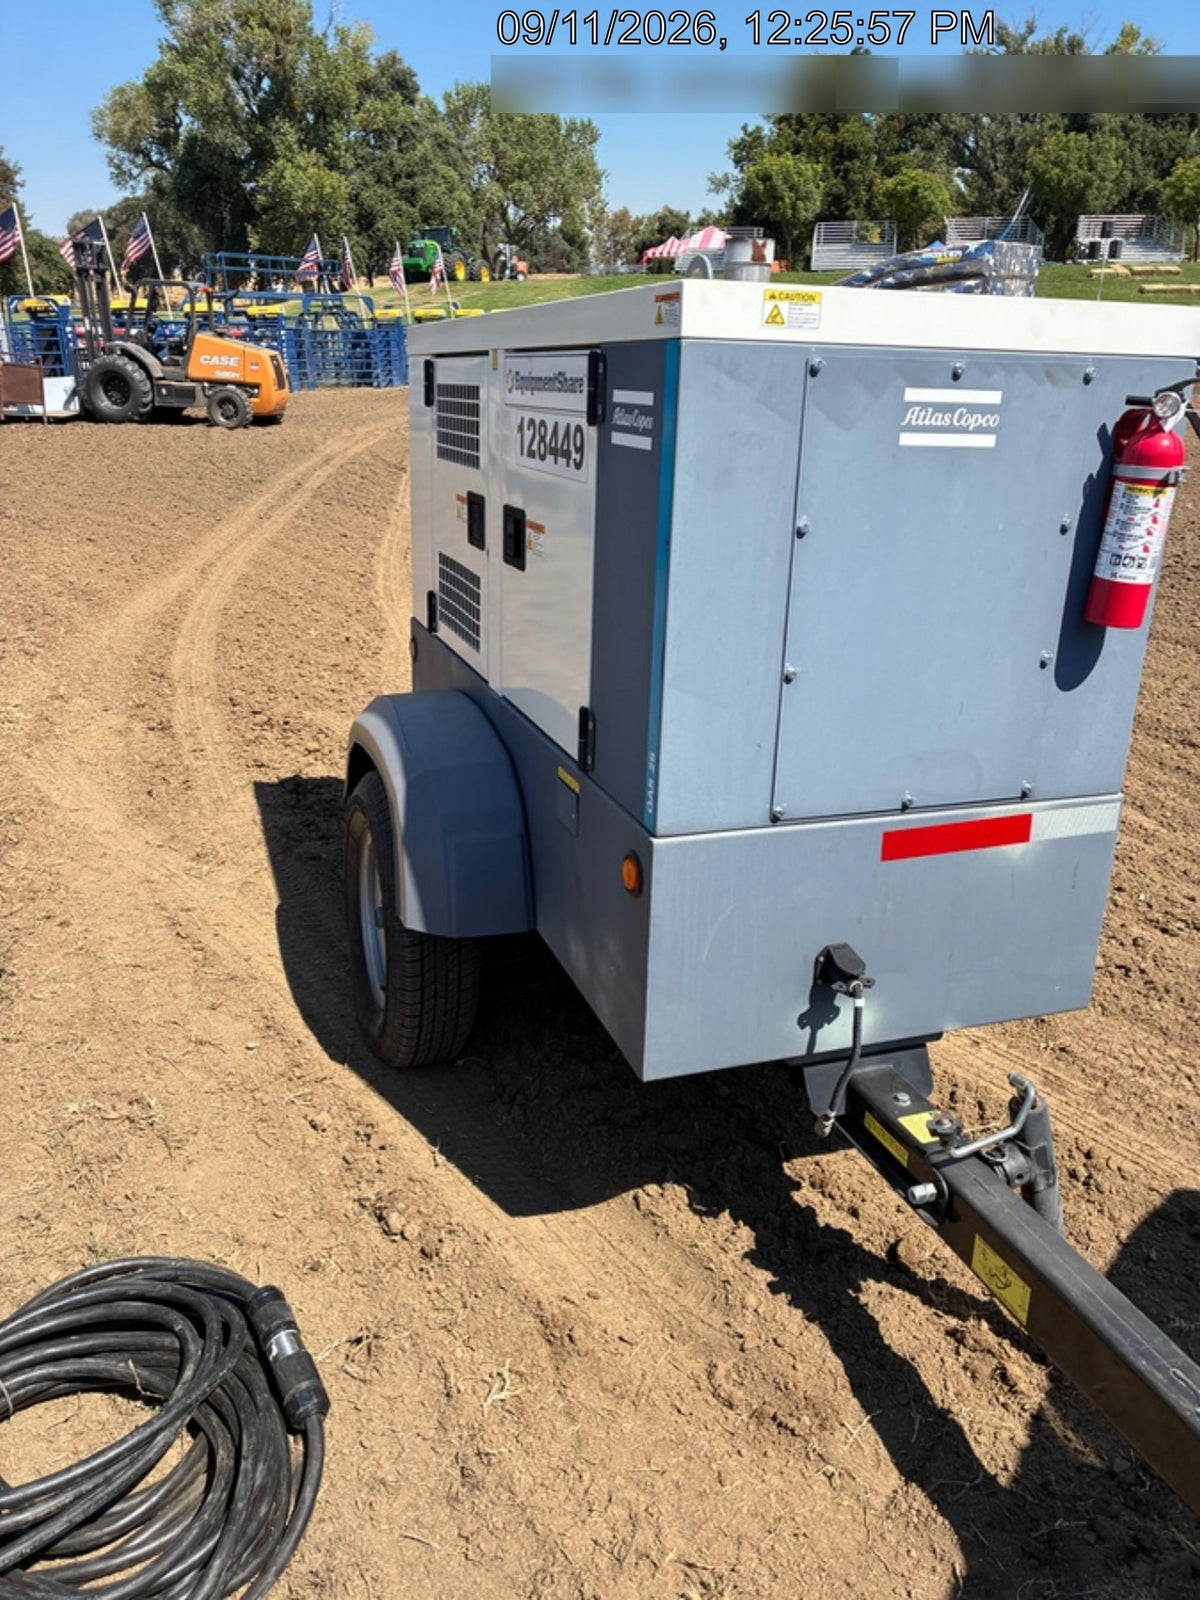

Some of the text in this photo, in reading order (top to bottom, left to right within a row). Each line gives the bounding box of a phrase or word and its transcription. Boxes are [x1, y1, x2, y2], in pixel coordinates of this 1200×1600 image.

[778, 291, 816, 302] CAUTION
[199, 354, 240, 367] CASE
[515, 370, 584, 396] EquipmentShare
[900, 406, 1000, 431] Atlas Copco
[516, 415, 585, 471] 128449
